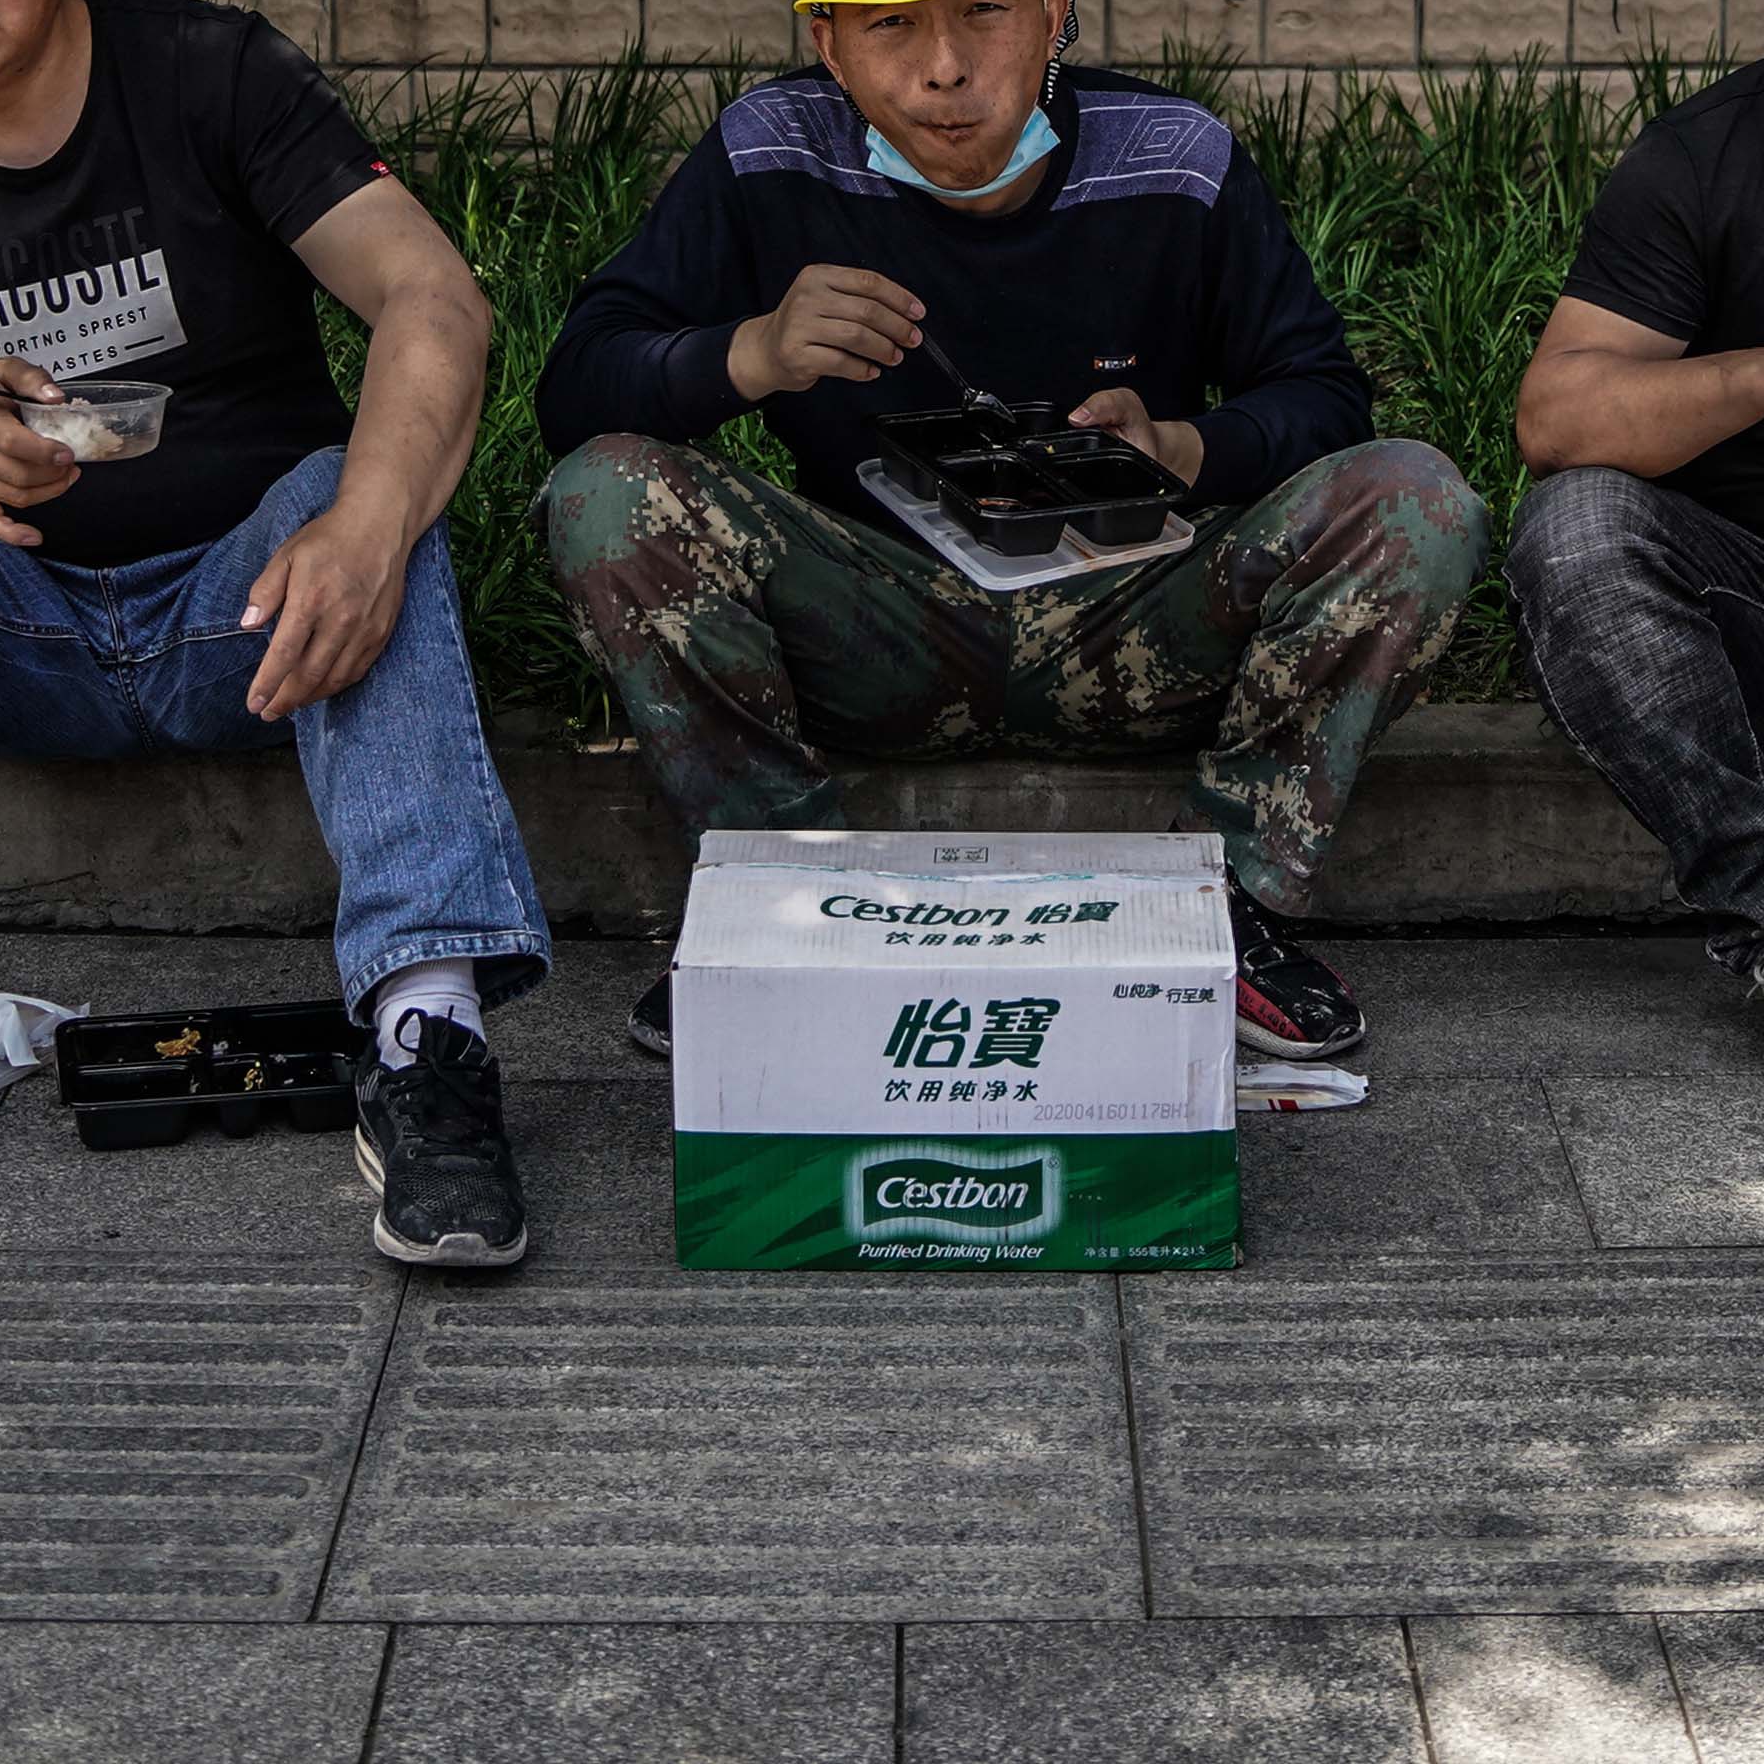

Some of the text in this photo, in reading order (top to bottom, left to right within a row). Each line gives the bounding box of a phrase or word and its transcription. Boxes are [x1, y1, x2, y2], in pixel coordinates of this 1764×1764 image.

[78, 306, 148, 338] SPREST
[39, 345, 118, 374] ASTES
[884, 930, 1047, 946] 饮用纯净水
[883, 997, 1061, 1068] 怡寶
[884, 1078, 1039, 1103] 饮用纯净水
[858, 1243, 1045, 1263] Purified Drinking Water
